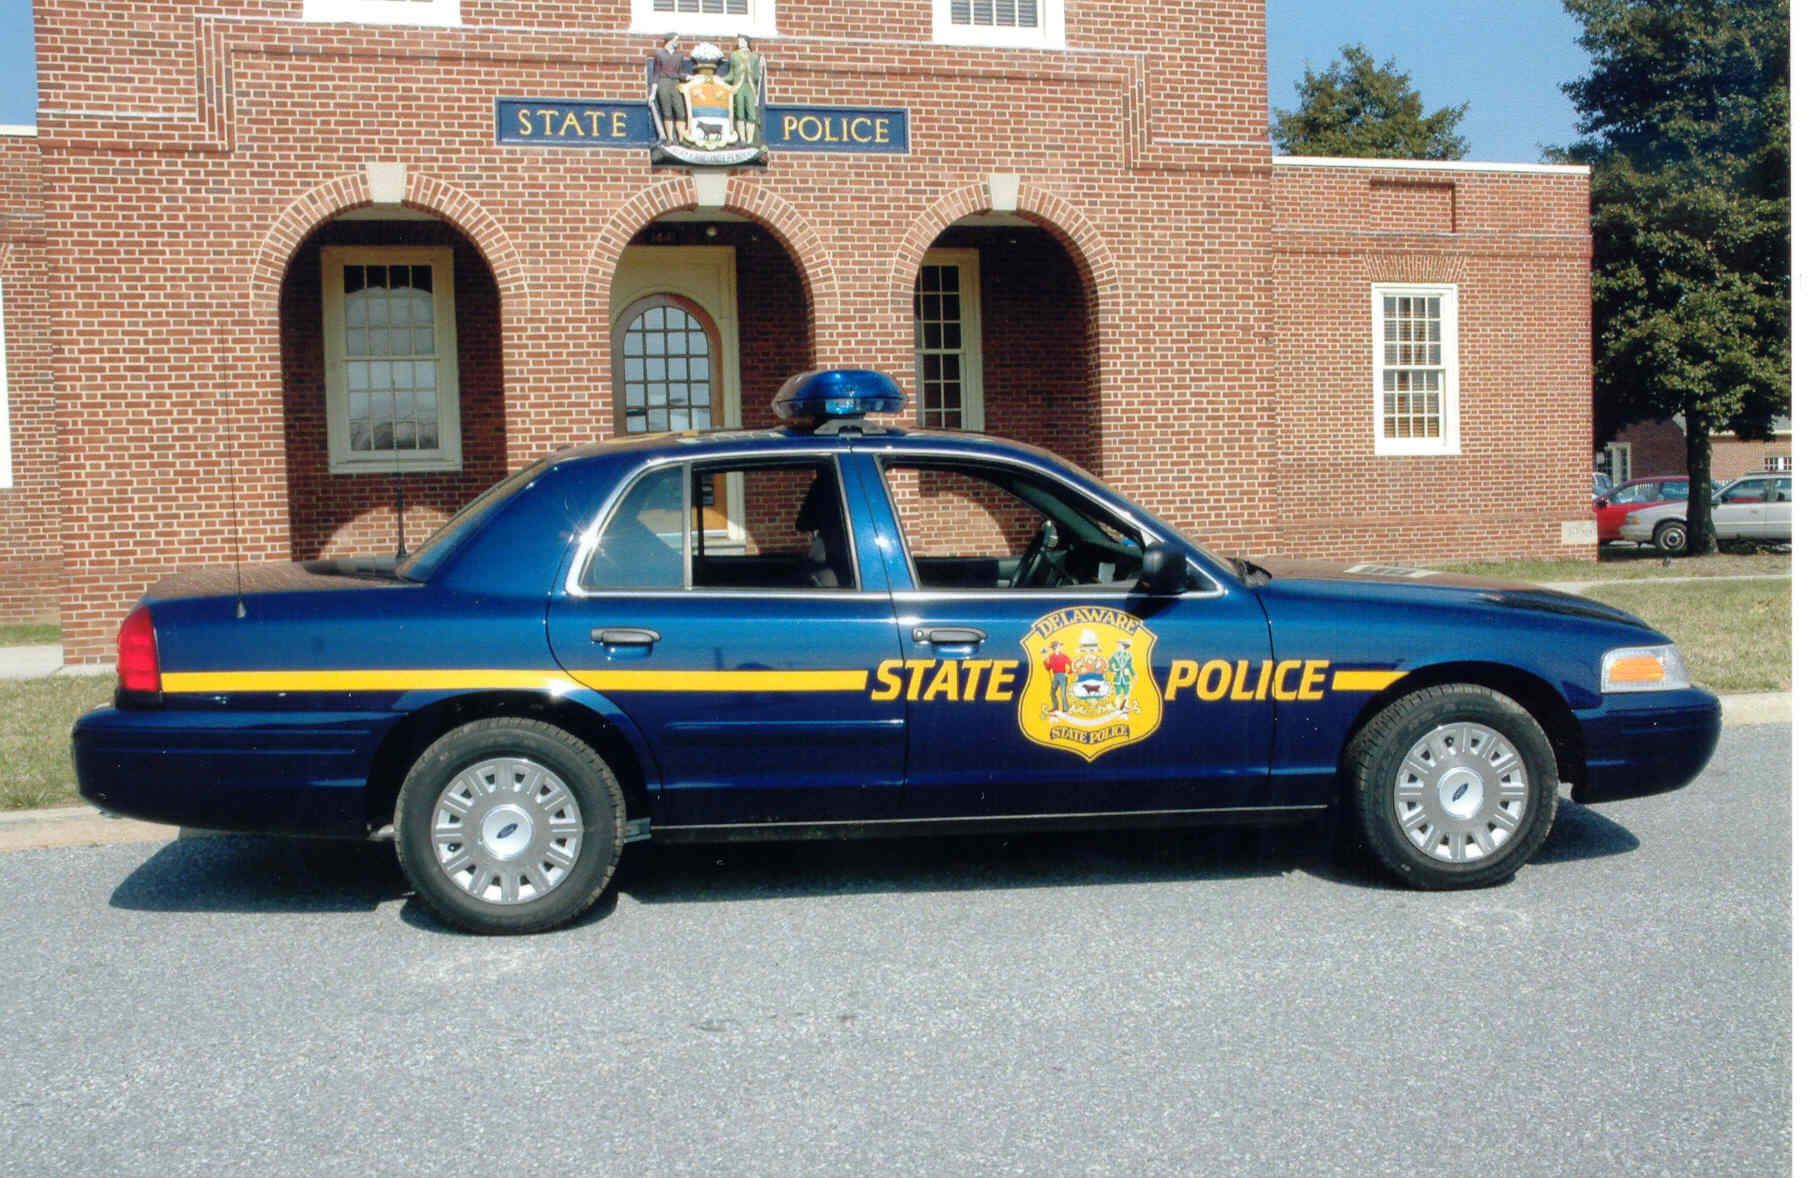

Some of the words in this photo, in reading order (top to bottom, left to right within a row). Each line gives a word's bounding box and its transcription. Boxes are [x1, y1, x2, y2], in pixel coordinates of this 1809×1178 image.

[518, 108, 628, 138] STATE
[782, 115, 890, 143] POLICE
[1037, 607, 1139, 639] DELAWARE
[870, 658, 1020, 702] STATE
[1163, 658, 1332, 702] POLICE
[1051, 726, 1088, 743] STATE
